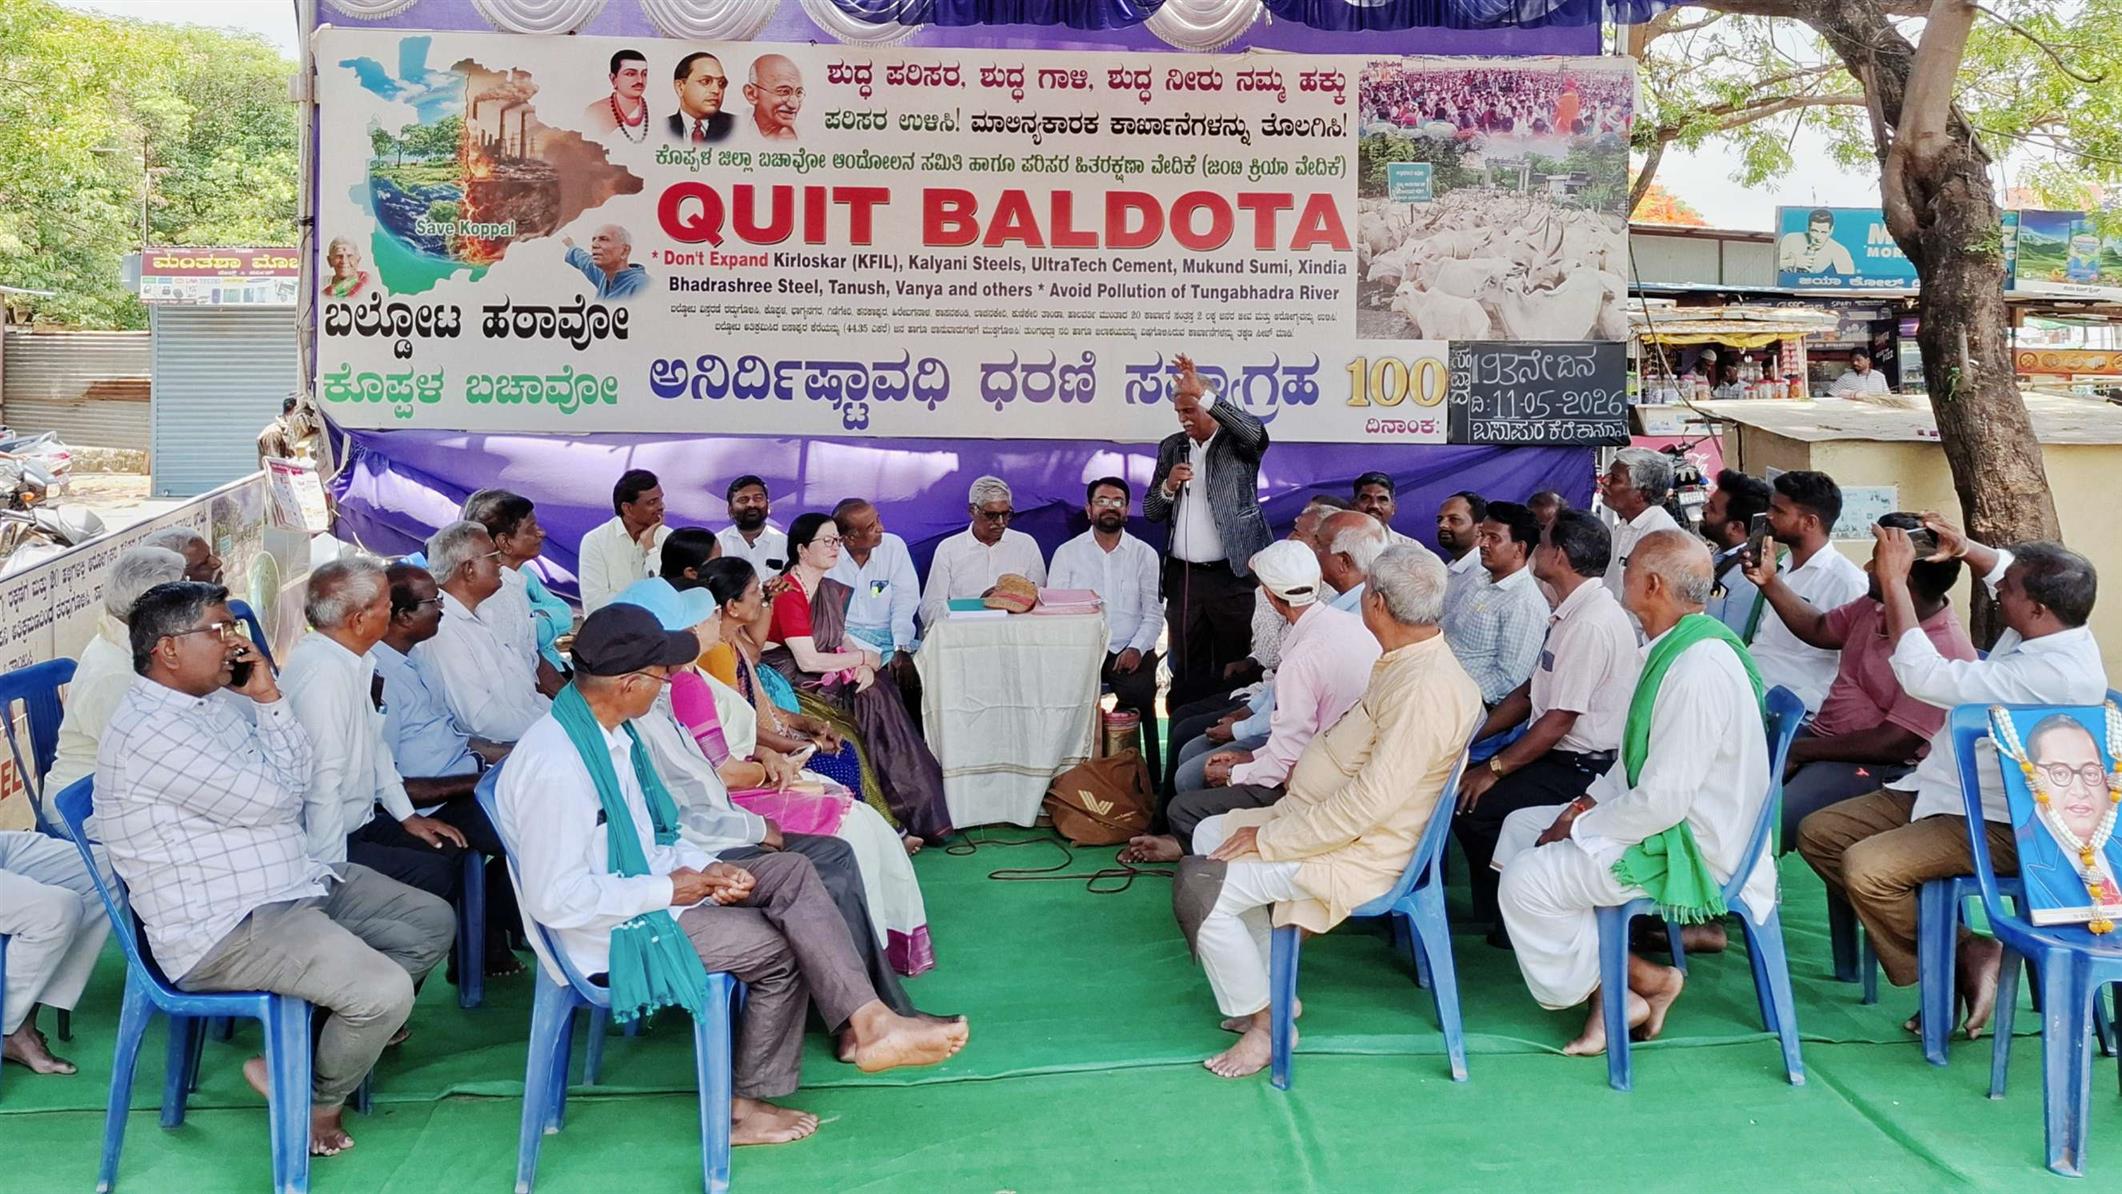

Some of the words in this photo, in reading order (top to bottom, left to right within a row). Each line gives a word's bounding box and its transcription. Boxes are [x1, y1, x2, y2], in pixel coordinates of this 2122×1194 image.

[827, 57, 873, 99] ಶುದ್ಧ
[886, 60, 966, 89] ಪರಿಸರ,
[979, 62, 1025, 103] ಶುದ್ಧ
[1038, 65, 1094, 92] ಗಾಳಿ,
[1107, 63, 1152, 105] ಶುದ್ಧ
[1165, 66, 1223, 91] ನೀರು
[1236, 65, 1287, 103] ನಮ್ಮ
[1300, 66, 1347, 105] ಹಕ್ಕು
[824, 107, 888, 131] ಪರಿಸರ
[899, 107, 961, 133] ಉಳಿಸಿ!
[971, 109, 1100, 146] ಮಾಲಿನ್ಯಕಾರಕ
[1110, 112, 1251, 146] ಕಾರ್ಖಾನೆಗಳನ್ನು
[1261, 112, 1347, 138] ತೊಲಗಿಸಿ!
[656, 144, 711, 172] ಕೊಪ್ಪಳ
[718, 147, 753, 172] ಜಿಲ್ಲಾ
[759, 147, 826, 174] ಬಚಾವೋ
[832, 150, 914, 171] ಆಂದೋಲನ
[921, 150, 962, 172] ಸಮಿತಿ
[969, 152, 1015, 174] ಹಾಗೂ
[1021, 154, 1069, 174] ಪರಿಸರ
[1075, 154, 1145, 183] ಹಿತರಕ್ಷಣಾ
[1151, 155, 1196, 175] ವೇದಿಕೆ
[1202, 154, 1243, 178] (ಜಂಟಿ
[1248, 156, 1288, 183] ಕ್ರಿಯಾ
[1295, 155, 1347, 178] ವೇದಿಕೆ)
[415, 220, 455, 236] Save
[459, 220, 516, 242] Koppal
[657, 181, 891, 247] QUIT
[922, 188, 1353, 252] BALDOTA
[664, 251, 704, 267] Don't
[709, 251, 769, 270] Expand
[773, 252, 846, 270] Kirloskar
[852, 254, 903, 273] (KFIL),
[909, 255, 967, 275] Kalyani
[973, 256, 1026, 275] Steels,
[1032, 257, 1107, 273] UltraTech
[1112, 258, 1177, 276] Cement,
[1183, 258, 1244, 275] Mukund
[1250, 259, 1293, 278] Sumi,
[1298, 259, 1347, 276] Xindia
[669, 276, 772, 294] Bhadrashree
[778, 278, 823, 297] Steel,
[828, 279, 890, 298] Tanush,
[896, 280, 943, 300] Vanya
[948, 281, 977, 297] and
[983, 282, 1032, 298] others
[1050, 283, 1091, 299] Avoid
[1097, 283, 1166, 300] Pollution
[1171, 284, 1186, 300] of
[1191, 284, 1294, 304] Tungabhadra
[1300, 286, 1340, 302] River
[324, 291, 461, 360] ಬಲ್ಡೋಟ
[482, 294, 629, 351] ಹಠಾವೋ
[323, 362, 444, 419] ಕೊಪ್ಪಳ
[465, 364, 618, 415] ಬಚಾವೋ
[650, 347, 950, 430] ಅನಿರ್ದಿಷ್ಟಾವಧಿ
[980, 349, 1096, 411] ಧರಣಿ
[1345, 357, 1447, 407] 100
[1365, 417, 1440, 435] ದಿನಾಂಕ:
